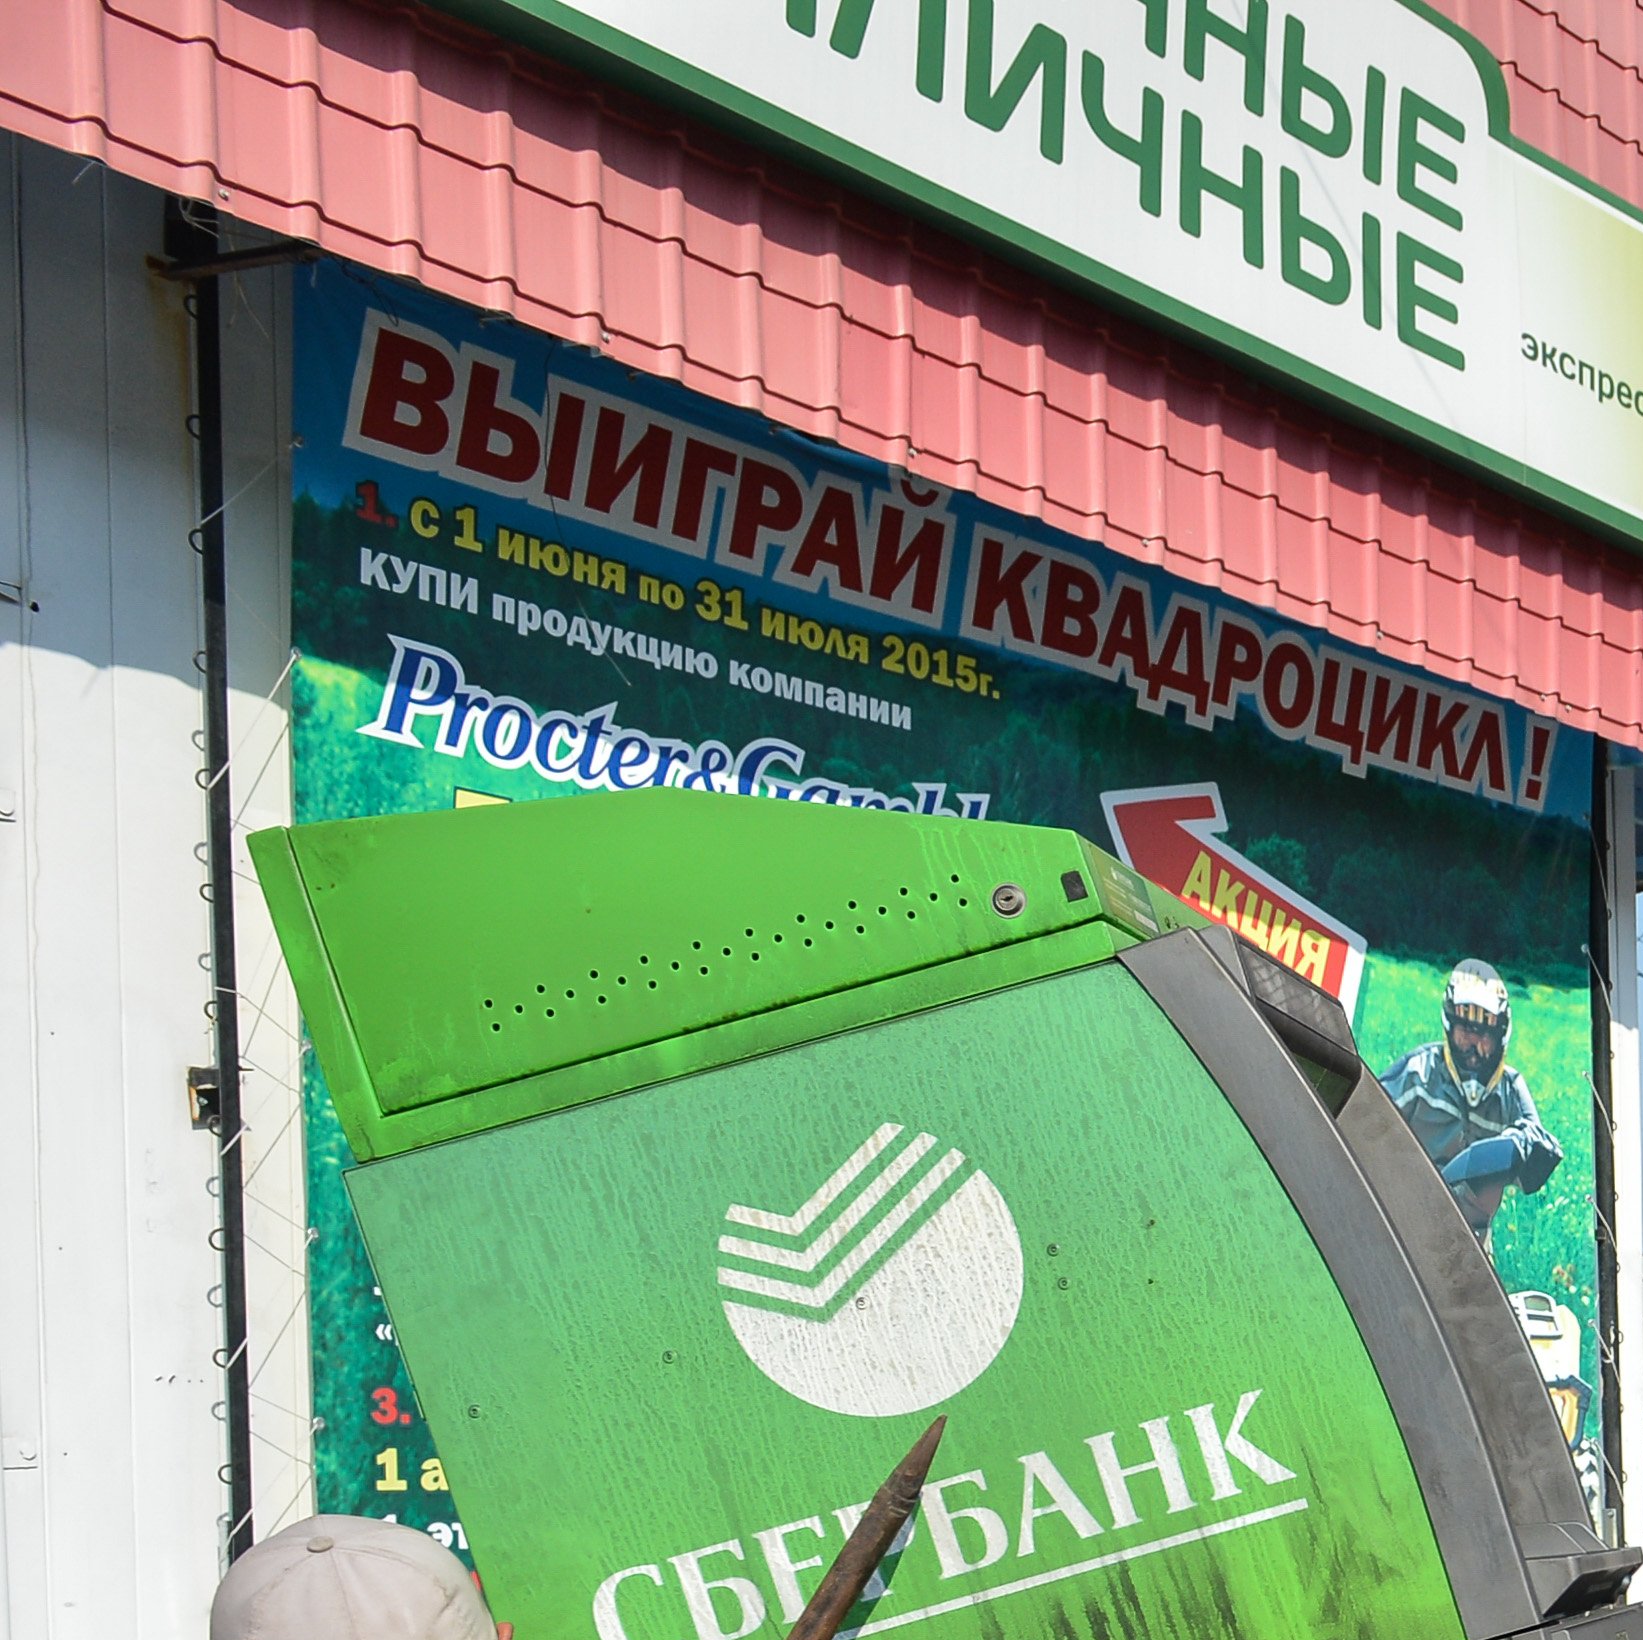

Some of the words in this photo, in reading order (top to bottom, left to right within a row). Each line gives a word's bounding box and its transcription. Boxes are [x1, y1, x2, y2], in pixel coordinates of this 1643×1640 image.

[786, 0, 1466, 372] ЛИЧНЫЕ
[355, 324, 951, 617] ВЫИГРАЙ
[359, 546, 480, 615] КУПИ
[492, 593, 719, 679] продукцию
[728, 659, 912, 731] компании
[454, 506, 484, 553] 1
[497, 526, 627, 595] июня
[638, 573, 685, 611] по
[695, 579, 749, 631] 31
[761, 606, 870, 665] июля
[881, 633, 1001, 700] 2015г.
[1180, 851, 1331, 987] АКЦИЯ
[370, 1387, 412, 1425] 3.
[375, 1447, 408, 1491] 1
